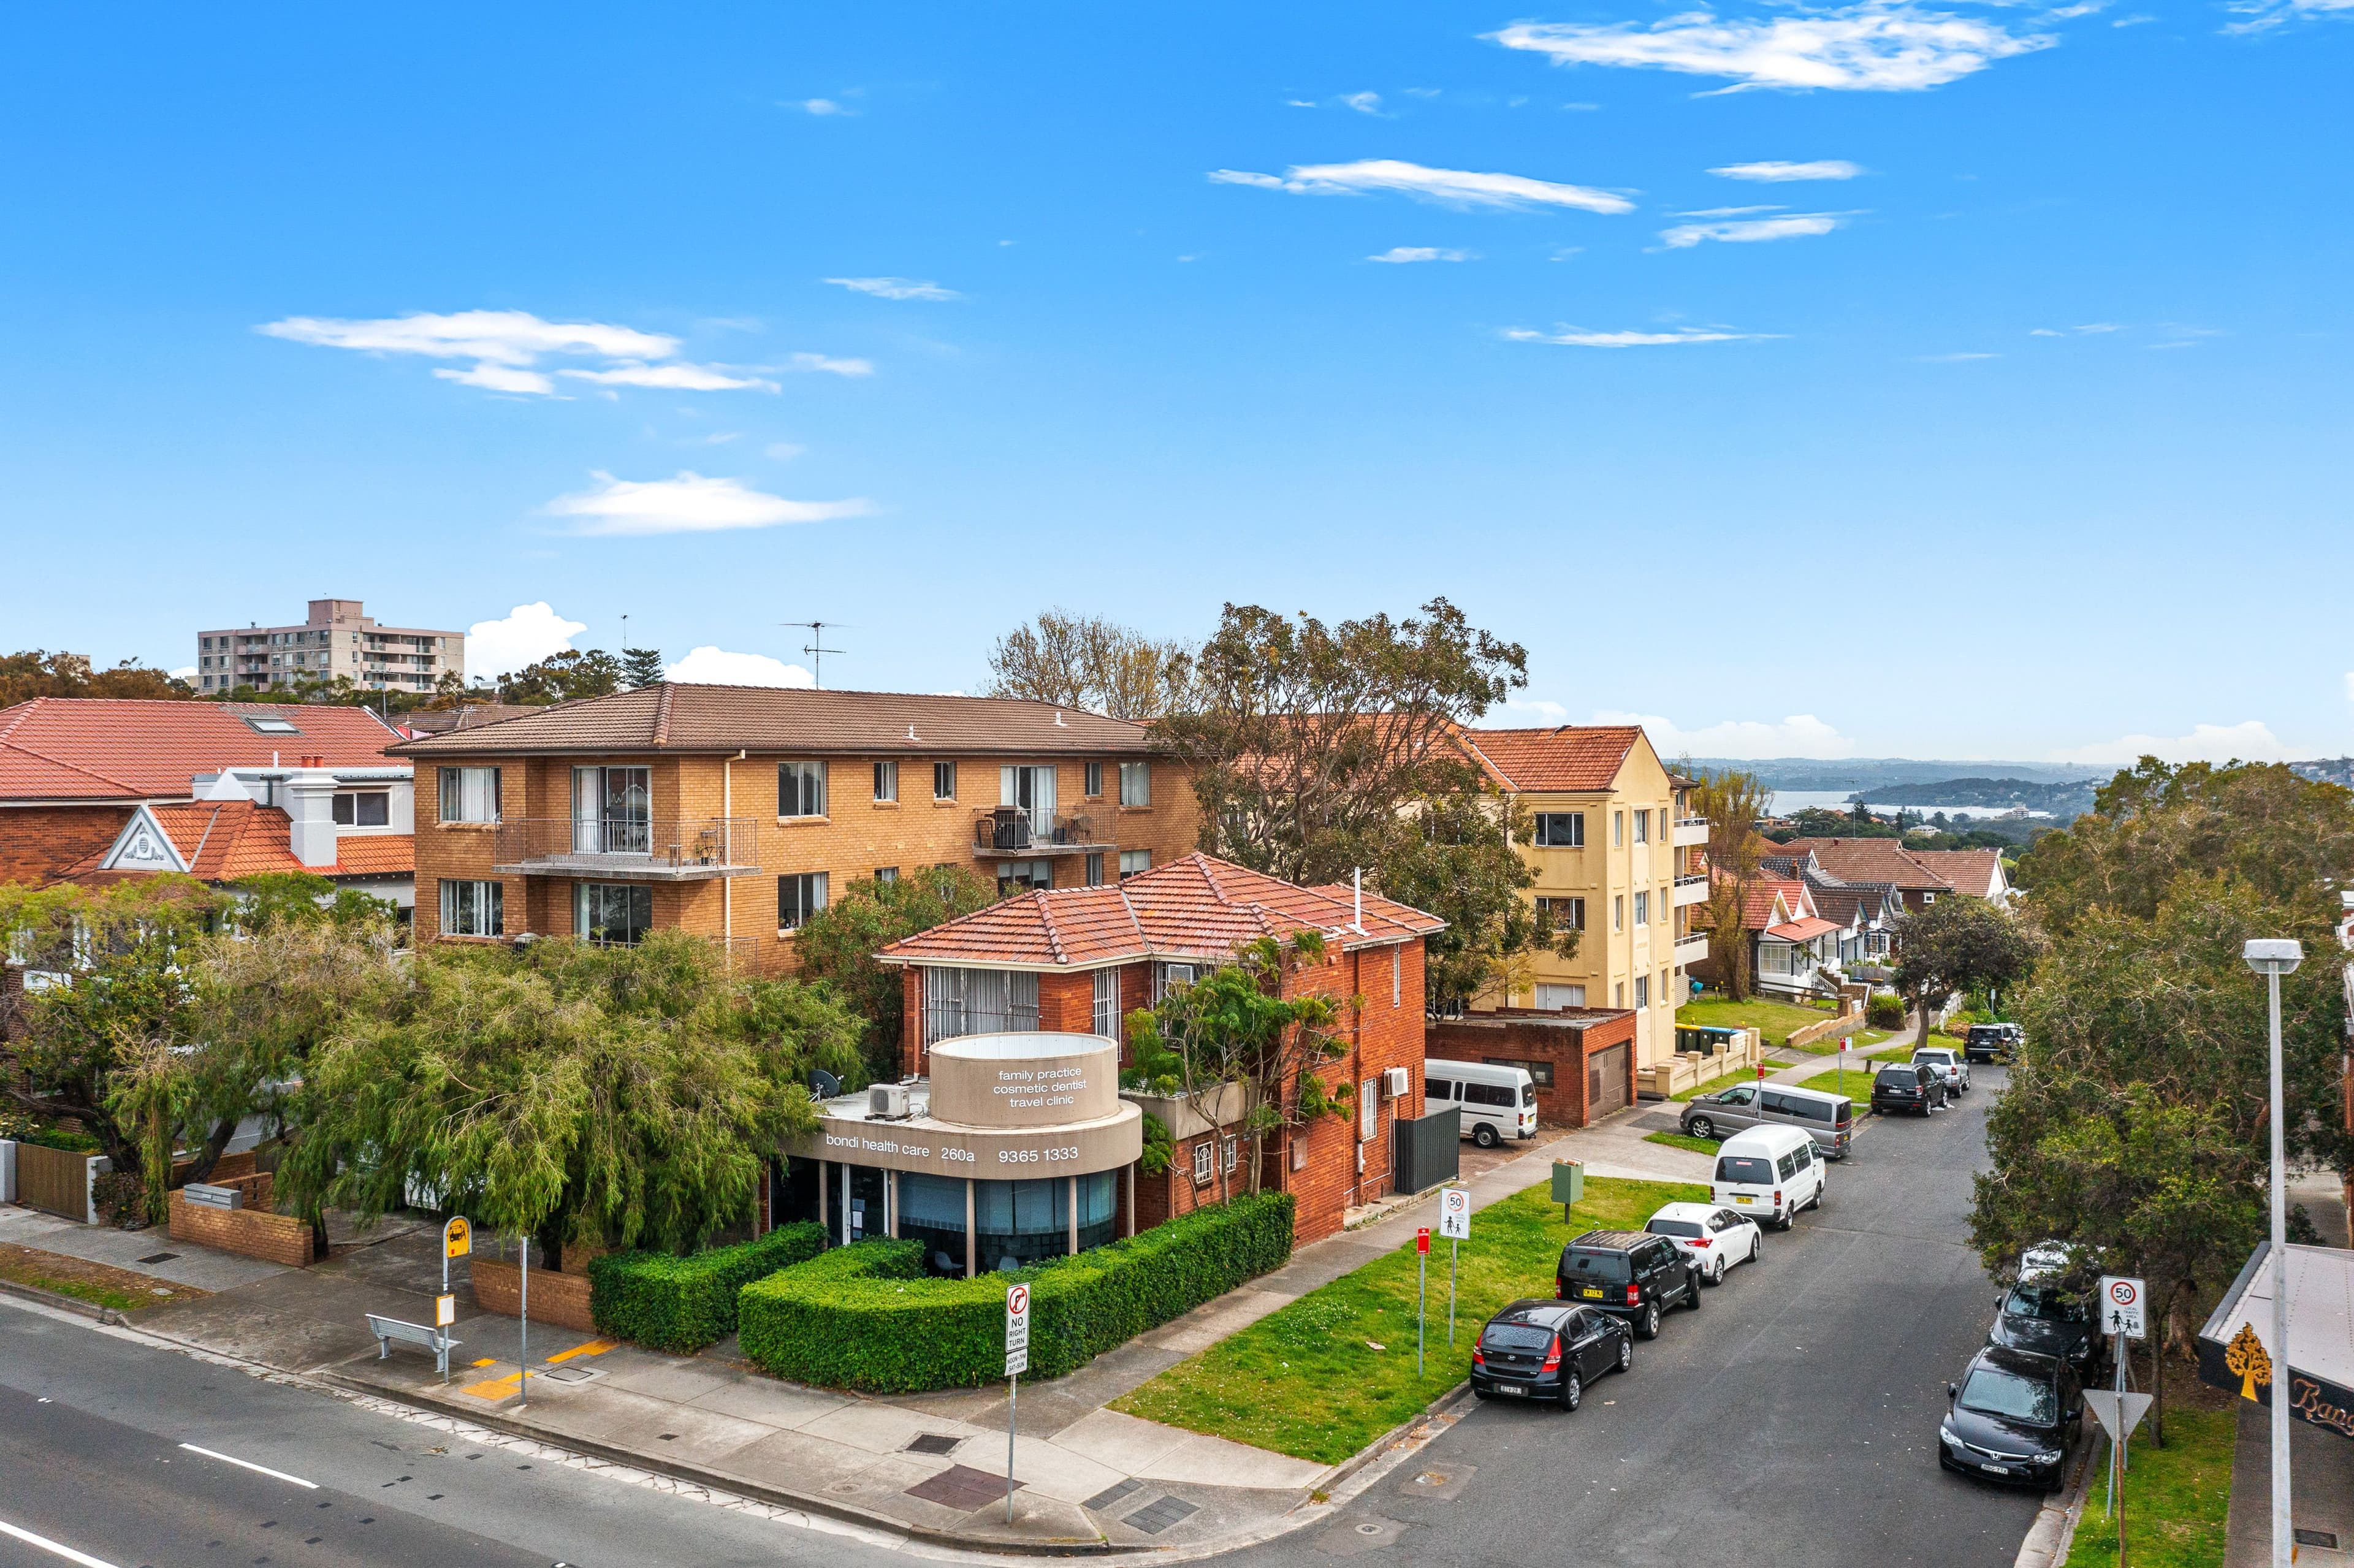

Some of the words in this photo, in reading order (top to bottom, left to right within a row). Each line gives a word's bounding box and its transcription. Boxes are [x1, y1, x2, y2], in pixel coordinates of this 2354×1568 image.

[999, 1070, 1034, 1082] family
[1037, 1067, 1082, 1081] practice
[993, 1083, 1048, 1094] cosmetic
[1051, 1079, 1087, 1092] dentist
[1010, 1097, 1043, 1108] travel
[1046, 1095, 1074, 1106] clinic
[826, 1133, 858, 1148] bondi
[863, 1138, 898, 1153] health
[902, 1145, 930, 1157] care
[941, 1147, 975, 1162] 260a
[999, 1150, 1038, 1163] 9365
[1043, 1147, 1078, 1161] 1333
[1450, 1197, 1461, 1206] 50
[2116, 1288, 2131, 1299] 50
[1011, 1317, 1023, 1328] NO
[1009, 1328, 1026, 1338] RIGHT
[1009, 1338, 1024, 1347] TURN
